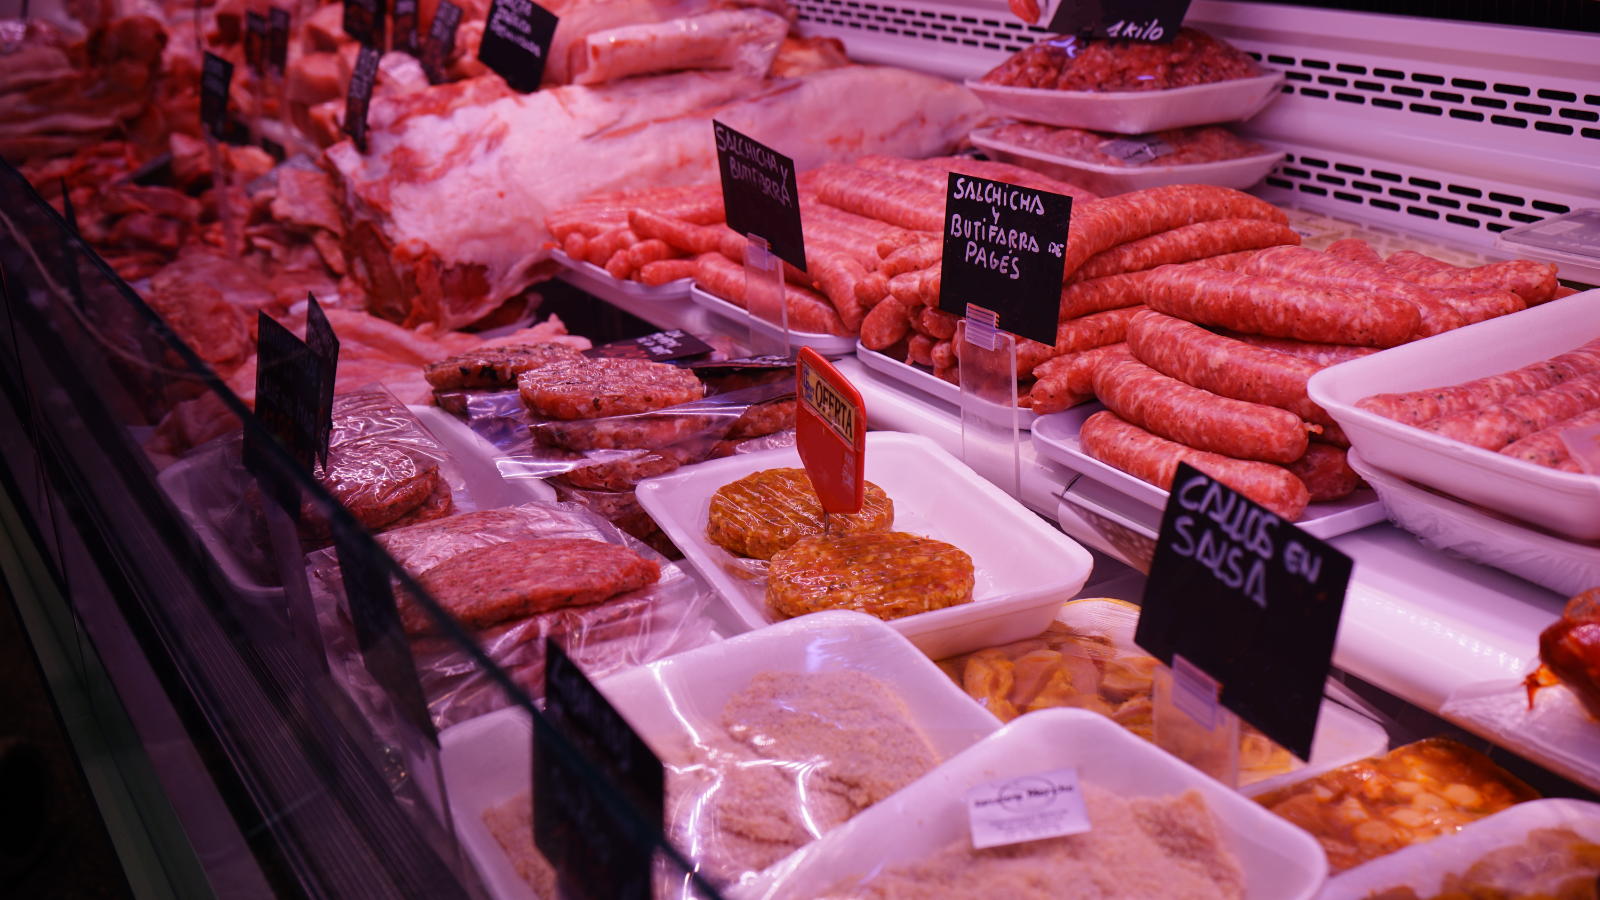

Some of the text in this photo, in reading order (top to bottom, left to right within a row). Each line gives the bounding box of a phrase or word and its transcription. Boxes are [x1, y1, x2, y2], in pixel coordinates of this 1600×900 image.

[715, 125, 779, 173] SALCHICHA
[953, 177, 1045, 216] SALCHICHA
[950, 213, 1040, 253] BUTIFARRA
[815, 380, 853, 439] OFERTA
[1177, 475, 1323, 584] CALLOS EN
[1170, 515, 1268, 609] SALSA
